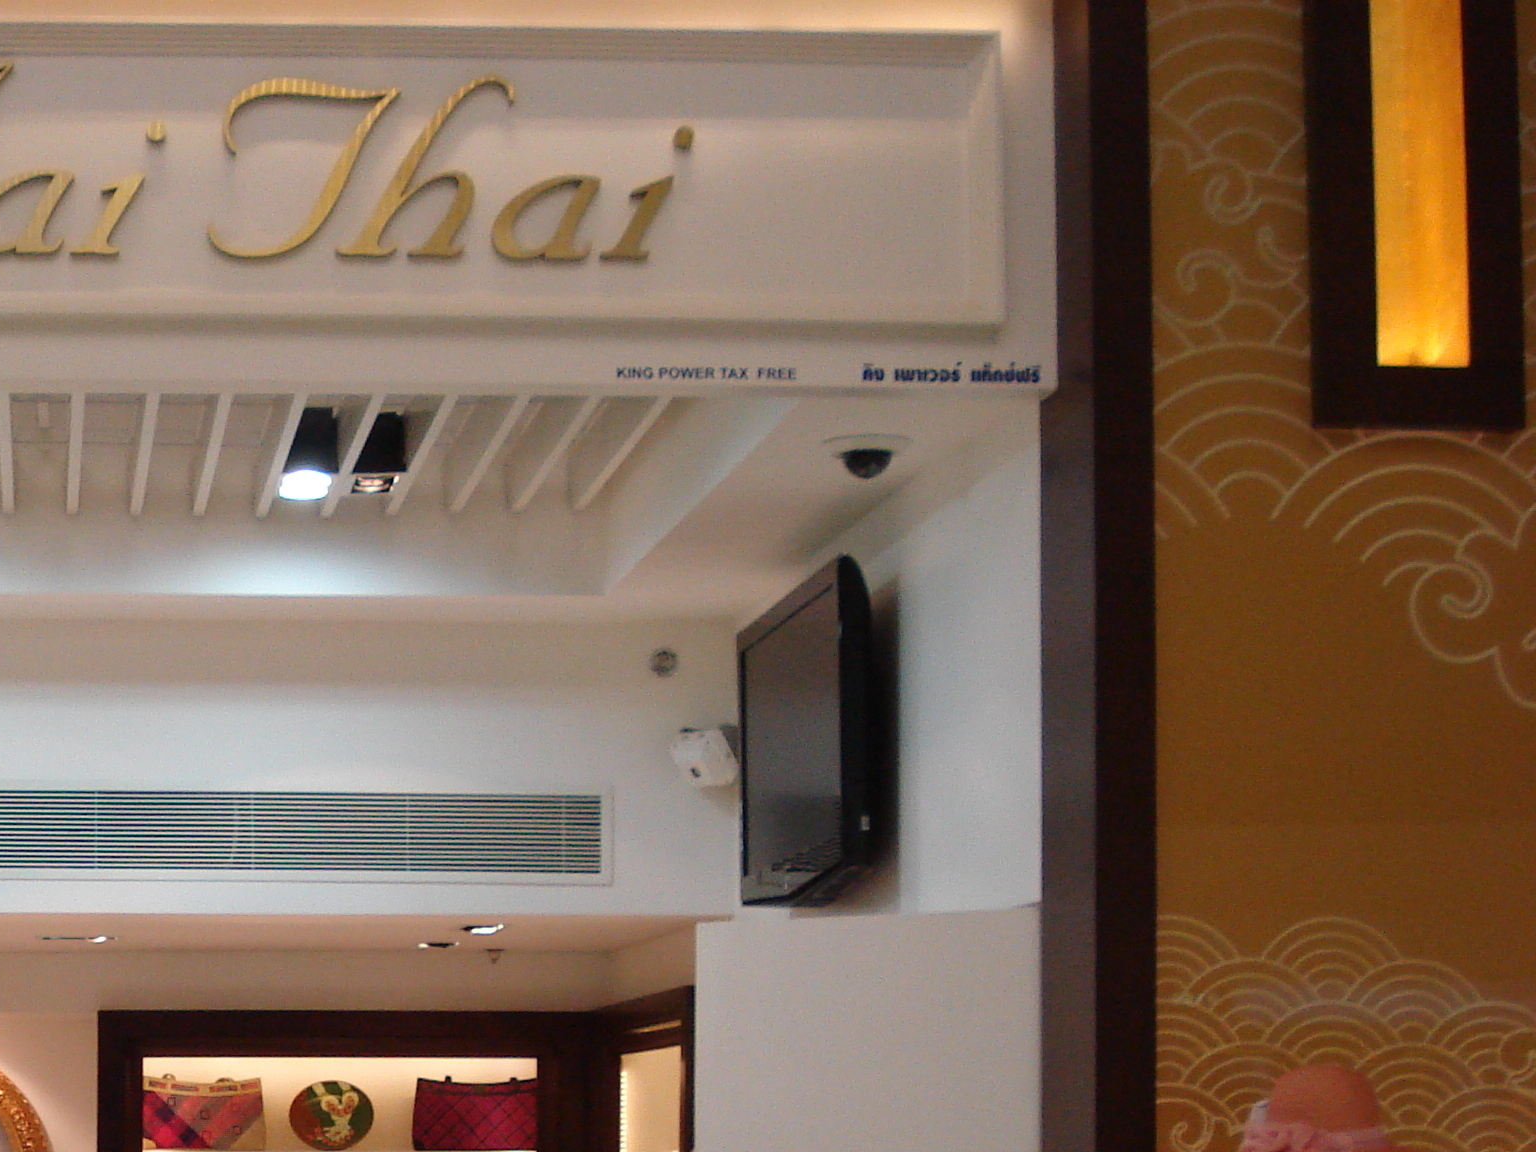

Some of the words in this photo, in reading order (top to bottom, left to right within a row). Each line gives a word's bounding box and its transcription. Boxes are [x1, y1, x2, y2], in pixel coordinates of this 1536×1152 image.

[205, 75, 697, 264] Thai
[616, 367, 654, 380] KING
[658, 367, 715, 380] POWER
[720, 367, 749, 380] TAX
[757, 367, 798, 381] FREE
